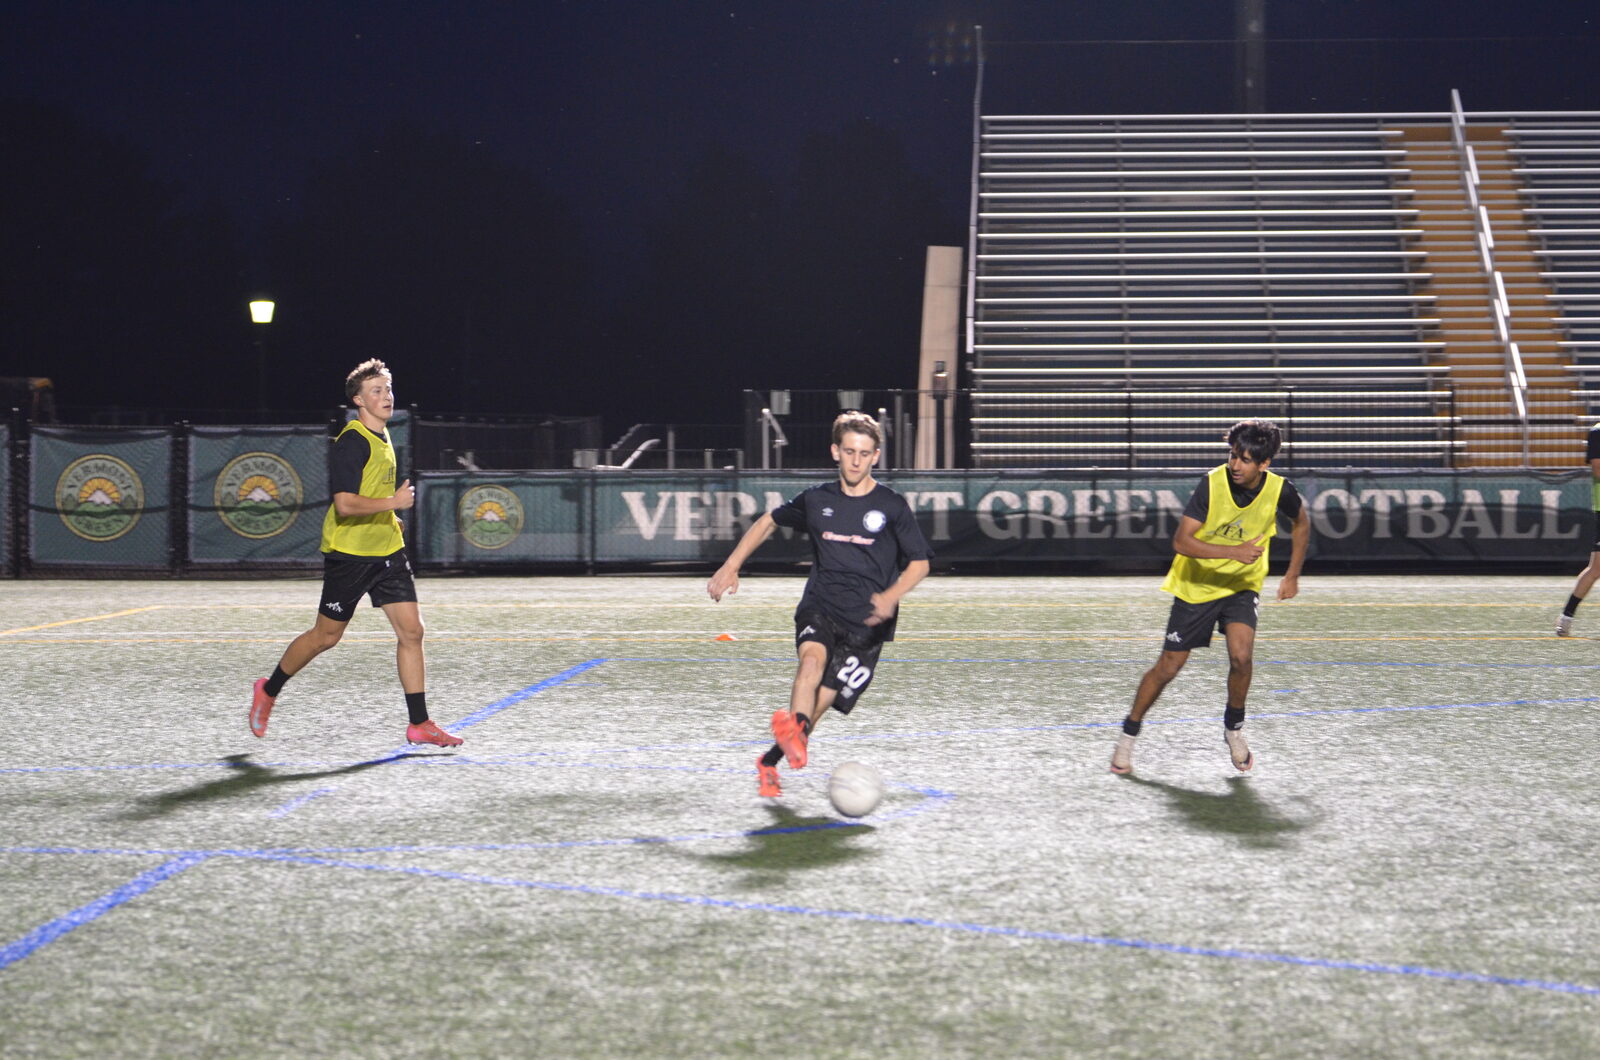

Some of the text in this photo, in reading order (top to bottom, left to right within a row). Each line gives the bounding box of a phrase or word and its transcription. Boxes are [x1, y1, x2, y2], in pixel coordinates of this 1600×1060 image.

[620, 490, 964, 541] VERT
[1274, 488, 1582, 540] OTBALL
[836, 655, 871, 690] 20
